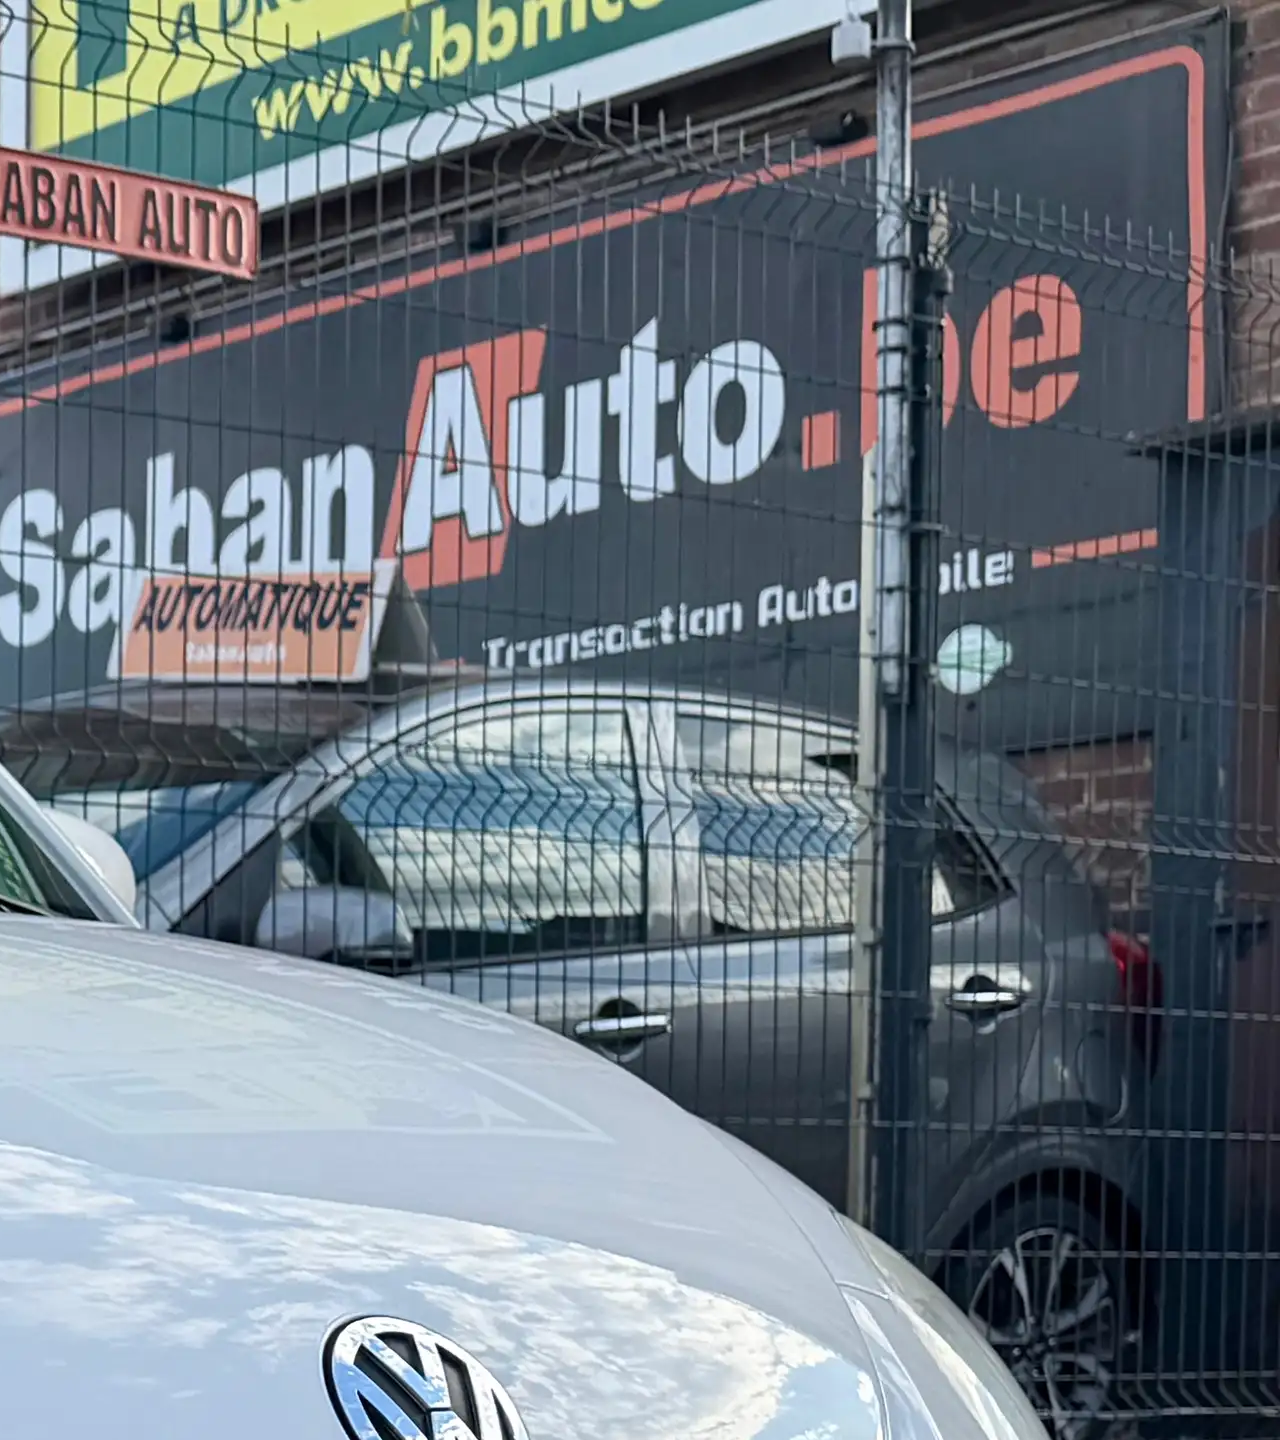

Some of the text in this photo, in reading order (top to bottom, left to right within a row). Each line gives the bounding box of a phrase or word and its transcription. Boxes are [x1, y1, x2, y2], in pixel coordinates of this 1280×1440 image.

[139, 187, 247, 267] AUTO
[132, 579, 372, 635] AUTOMATIQUE
[482, 600, 743, 670] Transaction
